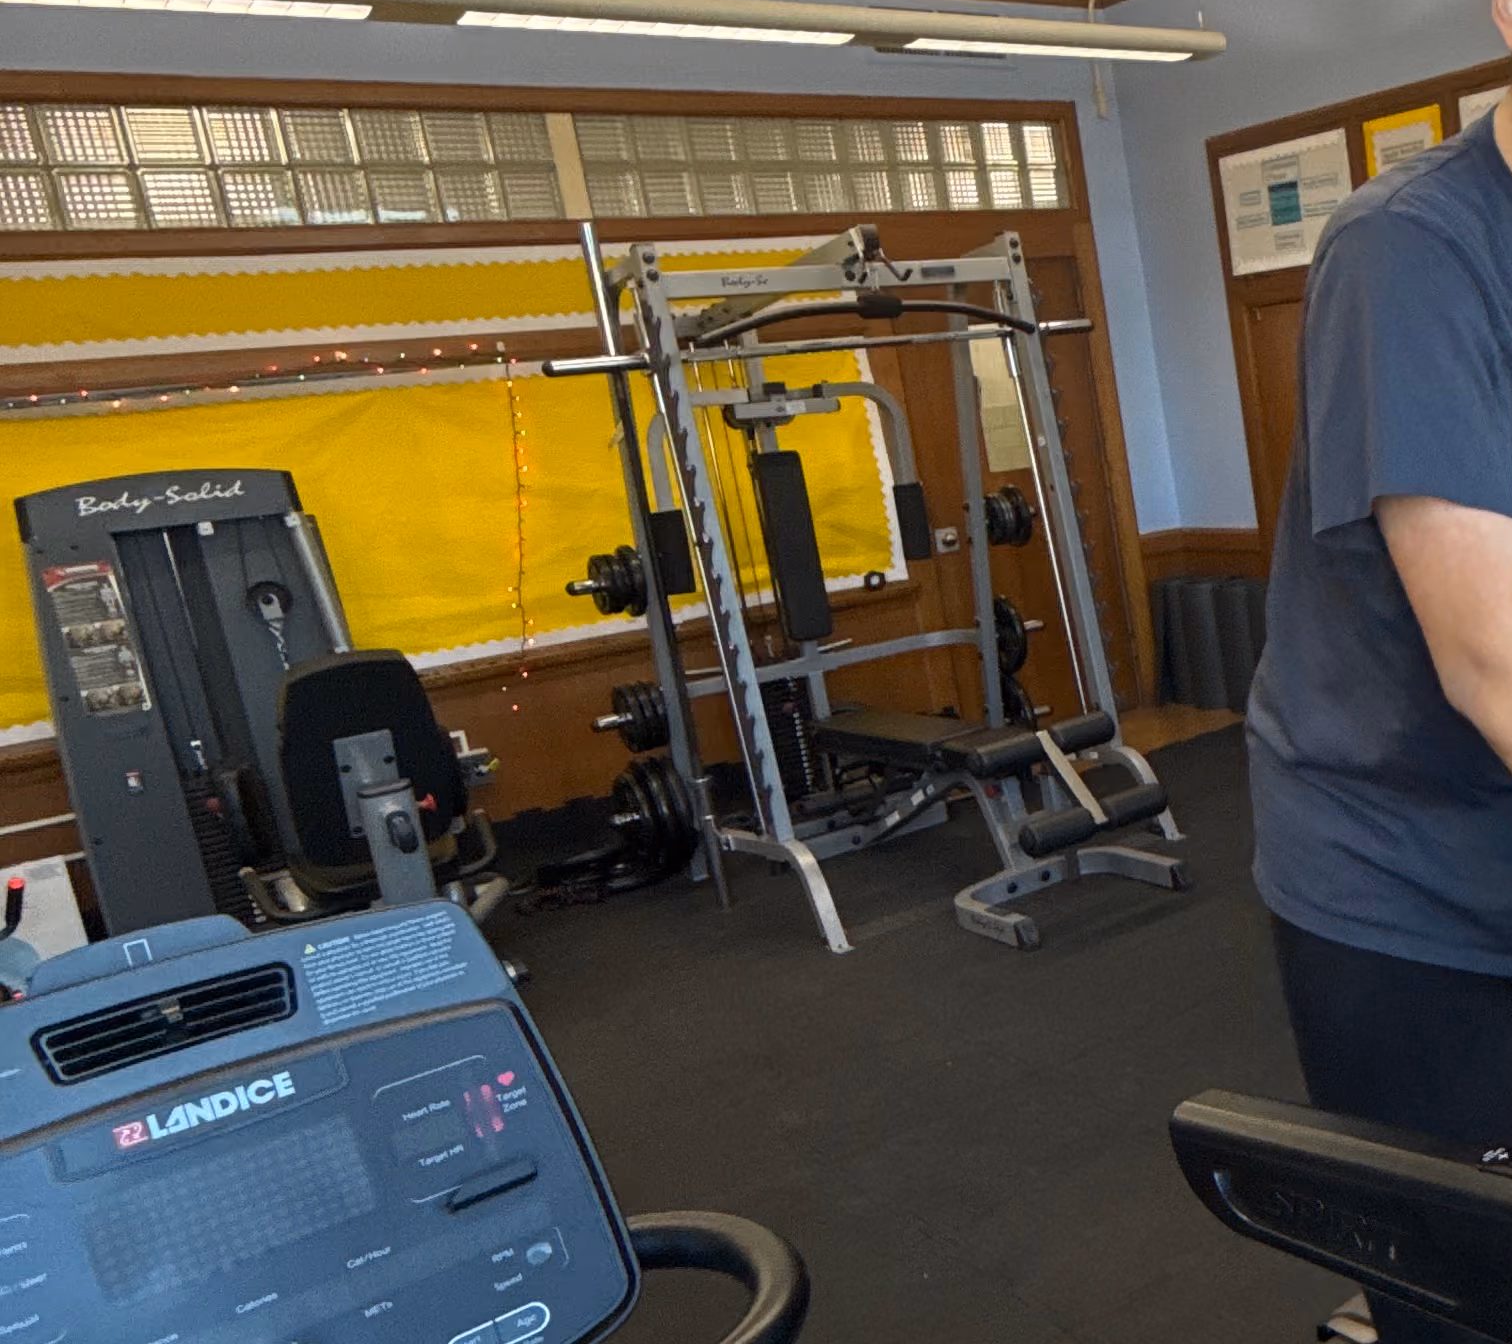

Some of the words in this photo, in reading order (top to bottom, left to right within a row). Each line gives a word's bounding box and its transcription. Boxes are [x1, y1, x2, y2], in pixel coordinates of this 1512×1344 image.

[75, 479, 246, 517] Body-Solid
[496, 1085, 527, 1103] Target
[146, 1070, 296, 1140] LANDICE
[402, 1107, 429, 1122] Heart
[429, 1098, 451, 1113] Rate
[503, 1098, 528, 1114] Zone
[418, 1150, 449, 1167] Target
[493, 1272, 523, 1292] Speed
[516, 1313, 538, 1329] Age
